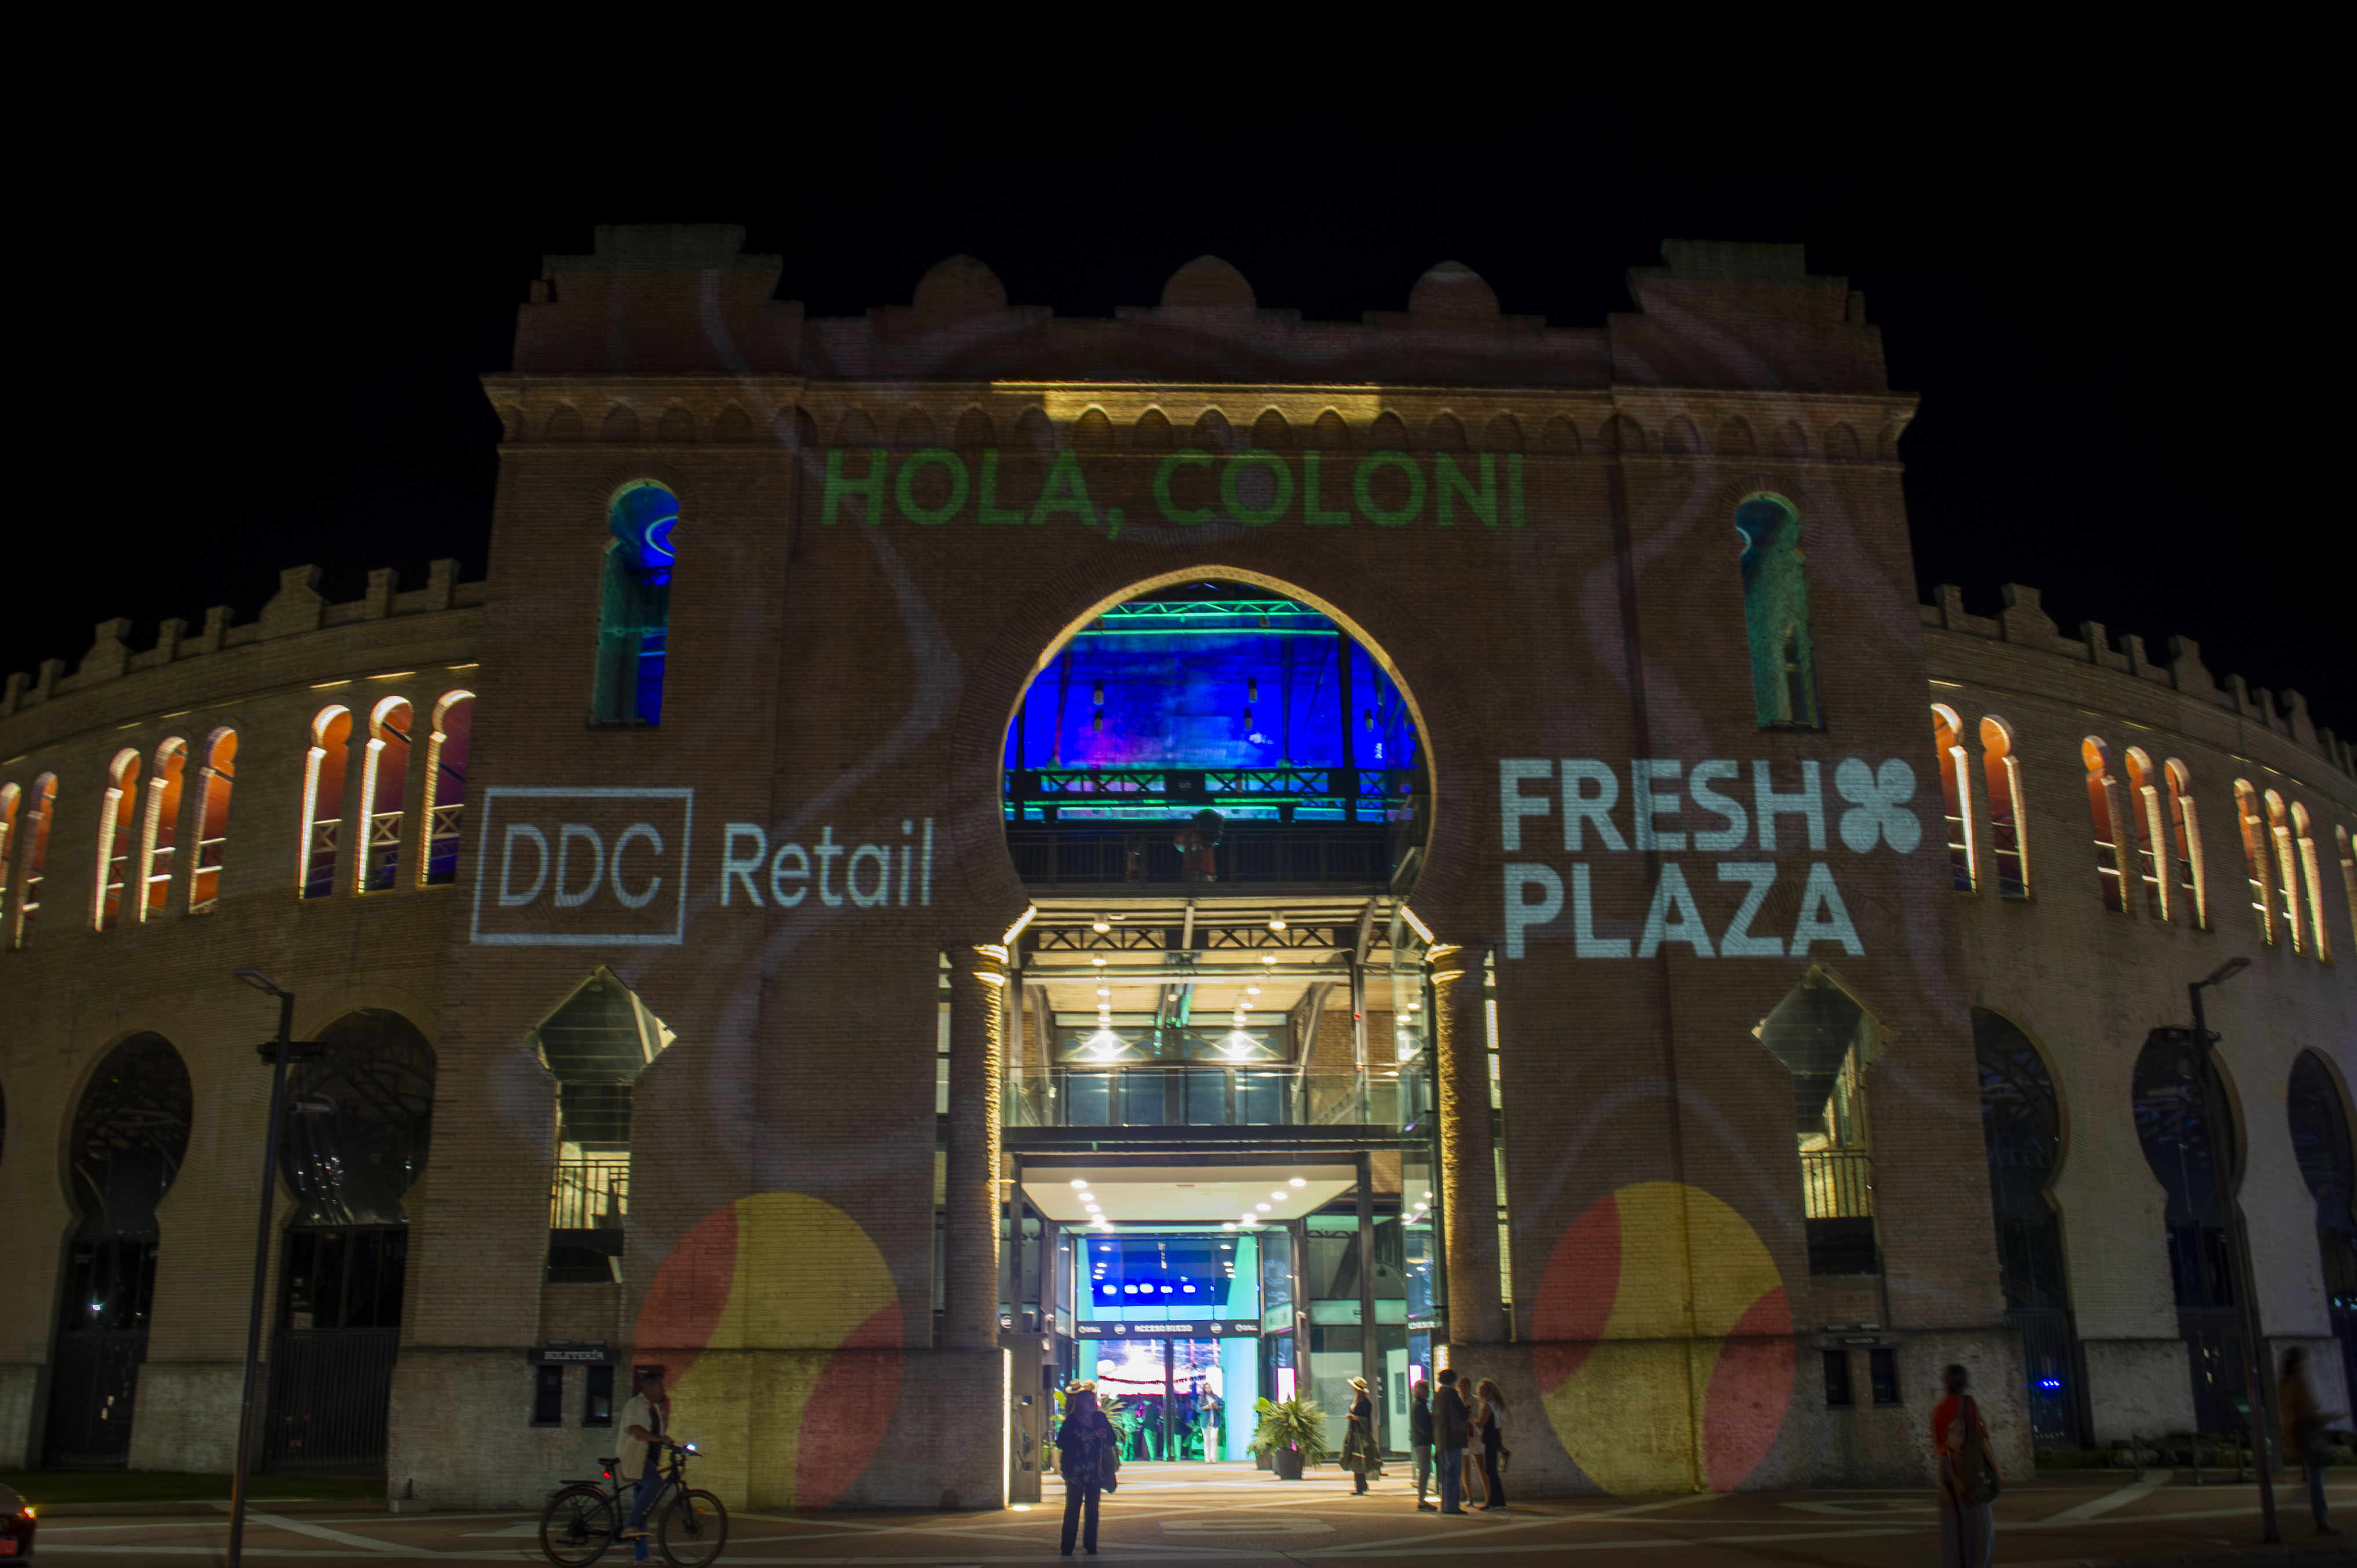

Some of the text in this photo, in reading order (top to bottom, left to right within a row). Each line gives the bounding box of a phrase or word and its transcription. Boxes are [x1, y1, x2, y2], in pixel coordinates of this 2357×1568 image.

[821, 448, 1125, 540] HOLA,
[1499, 758, 1827, 851] FRESH
[498, 817, 935, 909] DDC Retail
[1504, 862, 1866, 959] PLAZA
